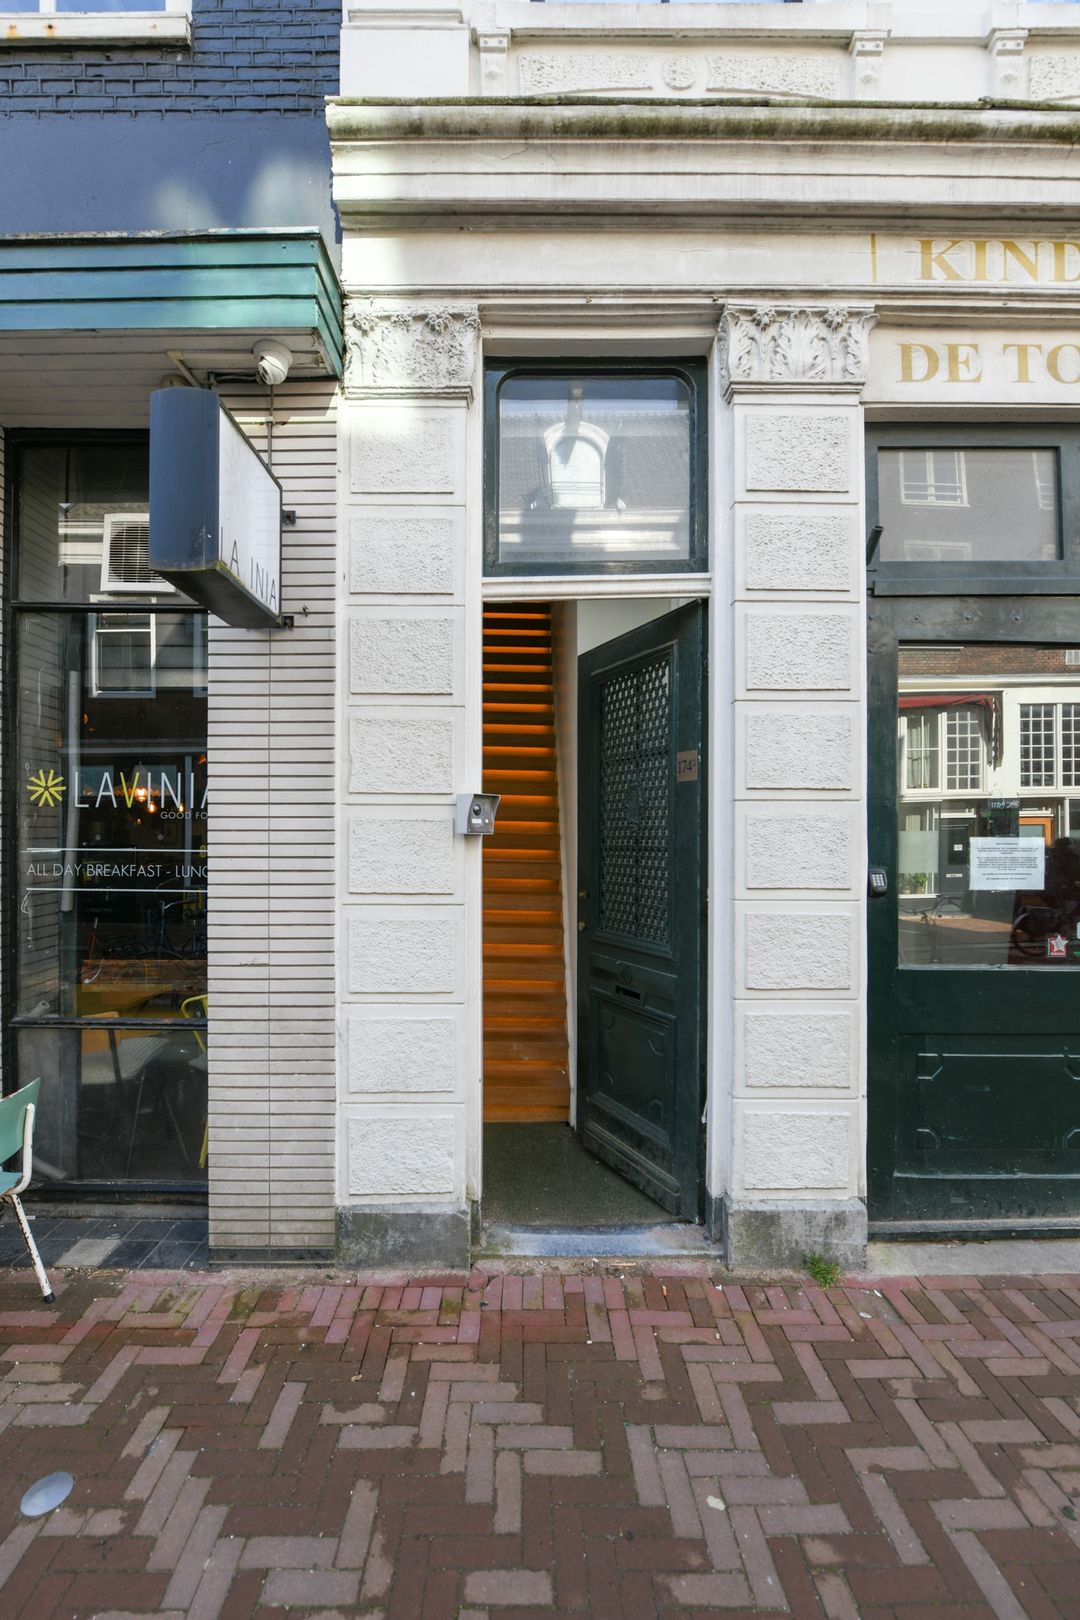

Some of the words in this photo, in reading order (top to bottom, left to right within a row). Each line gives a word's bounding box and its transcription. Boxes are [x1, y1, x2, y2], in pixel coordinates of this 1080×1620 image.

[915, 239, 1080, 283] KIND
[895, 342, 983, 384] DE
[1002, 342, 1080, 385] TO
[160, 811, 192, 820] GOOD
[26, 863, 48, 876] ALL
[53, 863, 82, 877] DAY
[86, 864, 162, 877] BREAKFAST
